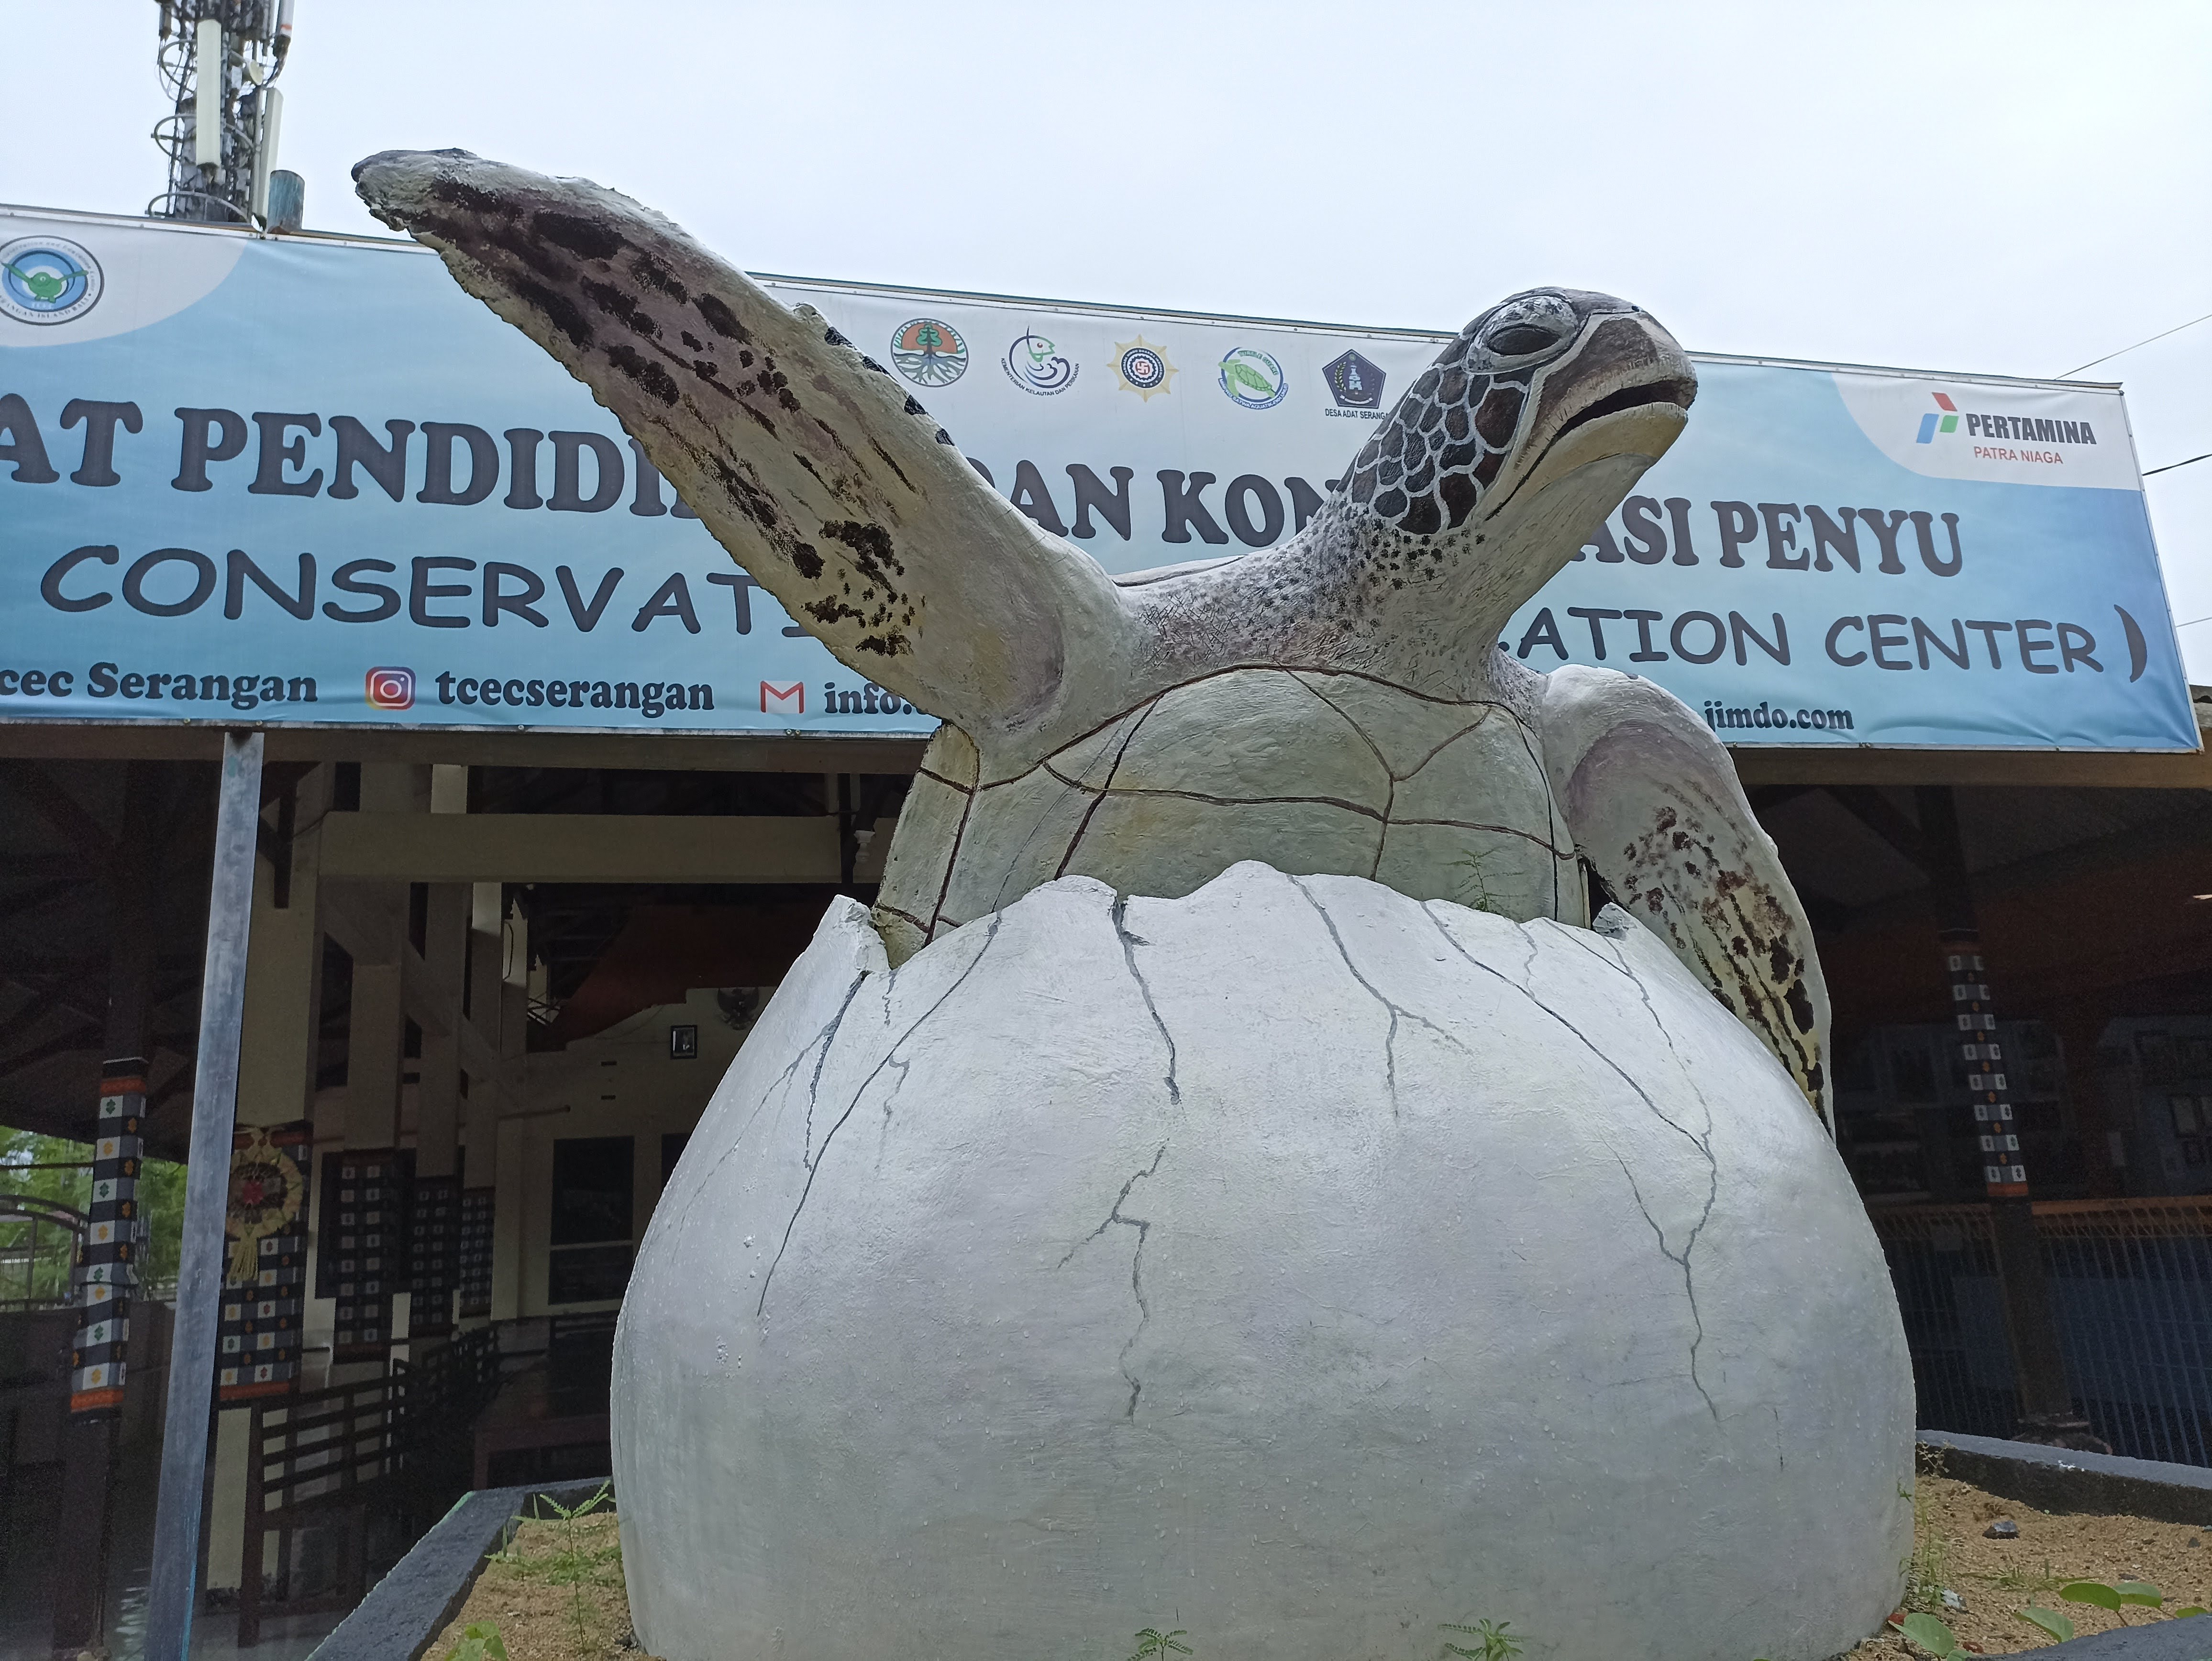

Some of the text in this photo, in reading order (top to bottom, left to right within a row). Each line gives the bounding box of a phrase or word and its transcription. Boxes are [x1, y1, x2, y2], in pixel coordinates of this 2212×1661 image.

[1001, 358, 1080, 396] KEMENTERIAN KELAUTAN DAN PERIKANAN
[1325, 408, 1386, 420] DESA ADAT SERANG
[1966, 413, 2097, 444] PERTAMINA
[1973, 446, 2063, 464] PATRA NIAGA
[0, 393, 144, 487] AT
[171, 408, 699, 519] PENDIDI
[1711, 500, 1962, 577] PENYU
[41, 545, 814, 637] CONSERVAT
[1498, 607, 1791, 666] ATION
[1825, 614, 2104, 674] CENTER
[0, 662, 318, 710] cec Serangan
[435, 671, 715, 719] tcecserangan
[824, 682, 927, 715] info.
[1704, 700, 1854, 732] jimdo.com
